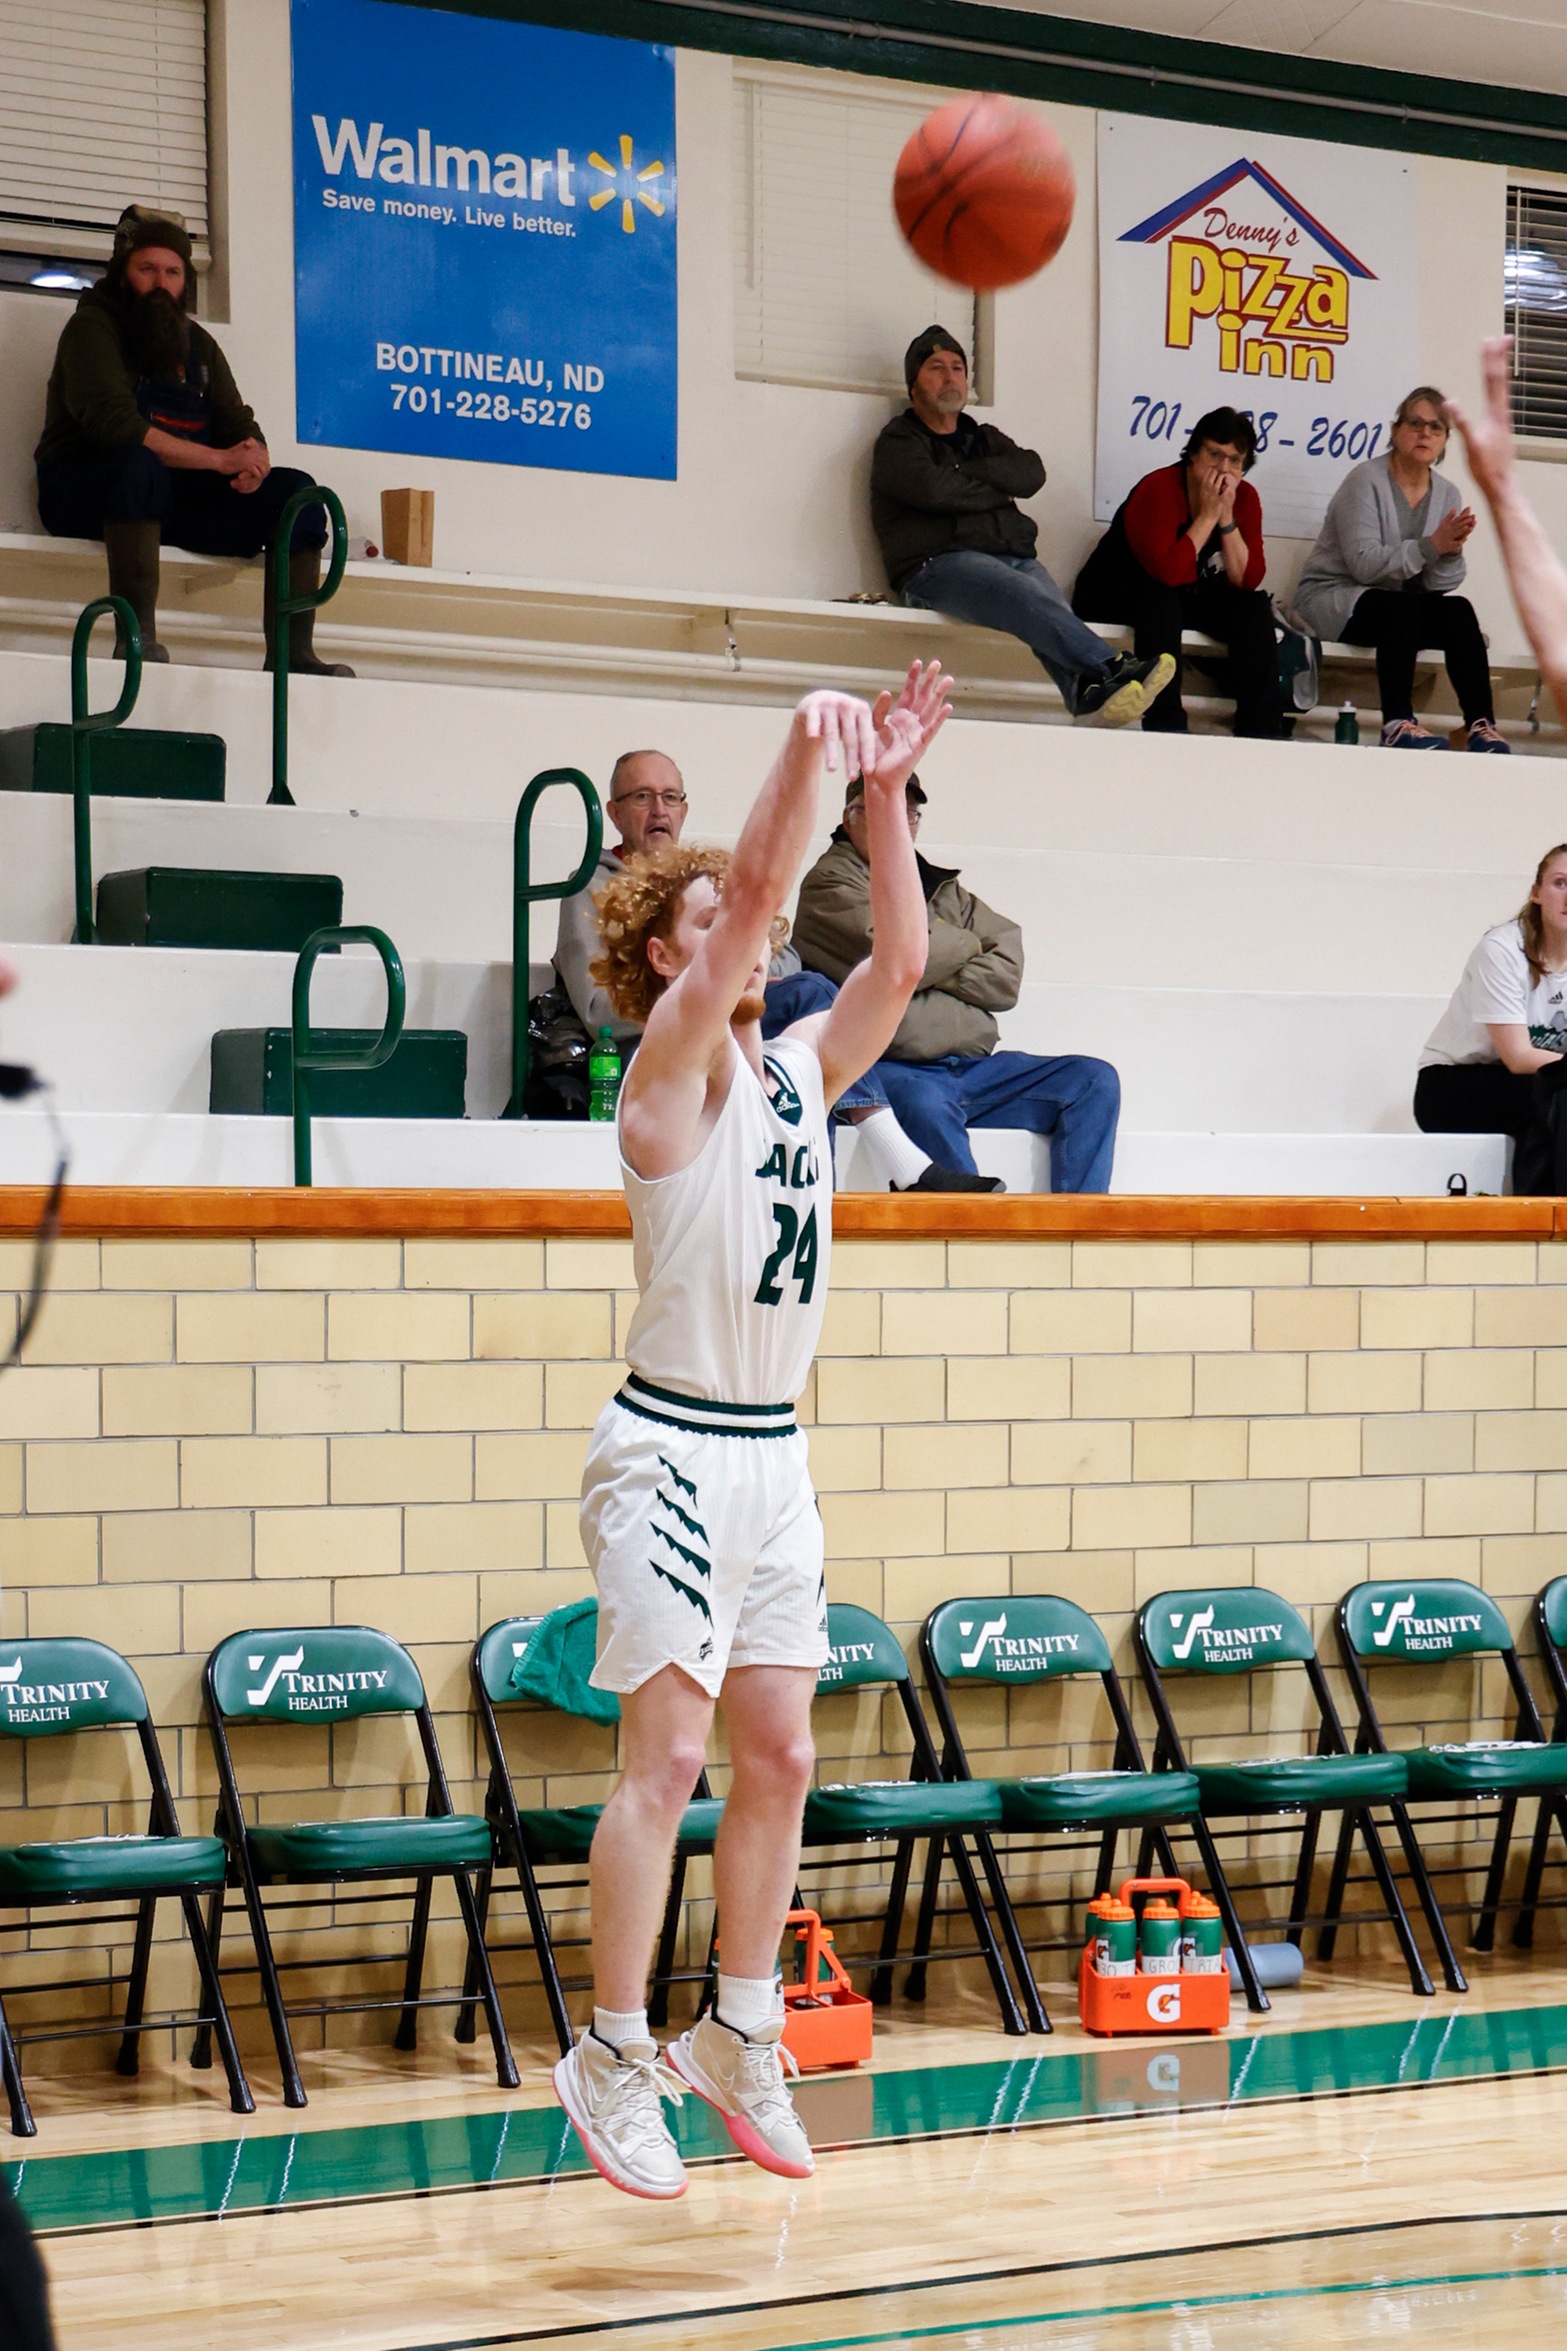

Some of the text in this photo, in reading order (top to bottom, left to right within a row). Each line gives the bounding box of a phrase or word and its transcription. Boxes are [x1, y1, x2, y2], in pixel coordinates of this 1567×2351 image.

[311, 114, 575, 207] Walmart
[322, 189, 577, 238] Save money. Live better.
[1203, 207, 1300, 254] Denny's
[376, 343, 605, 393] BOTTINEAU, ND
[390, 384, 592, 430] 701-228-5276
[753, 1202, 818, 1307] 24
[1197, 1624, 1283, 1647] TRINITY
[1398, 1614, 1482, 1635] TRINITY
[825, 1643, 875, 1663] NITY
[988, 1634, 1080, 1656] TRINITY
[1204, 1647, 1254, 1662] HEALTH
[1404, 1636, 1453, 1650] HEALTH
[818, 1667, 843, 1681] LTH
[995, 1657, 1048, 1672] HEALTH
[0, 1680, 110, 1705] TRINITY
[282, 1670, 388, 1693] TRINITY
[7, 1706, 71, 1722] HEALTH
[288, 1695, 349, 1711] HEALTH
[1146, 1983, 1181, 2023] G
